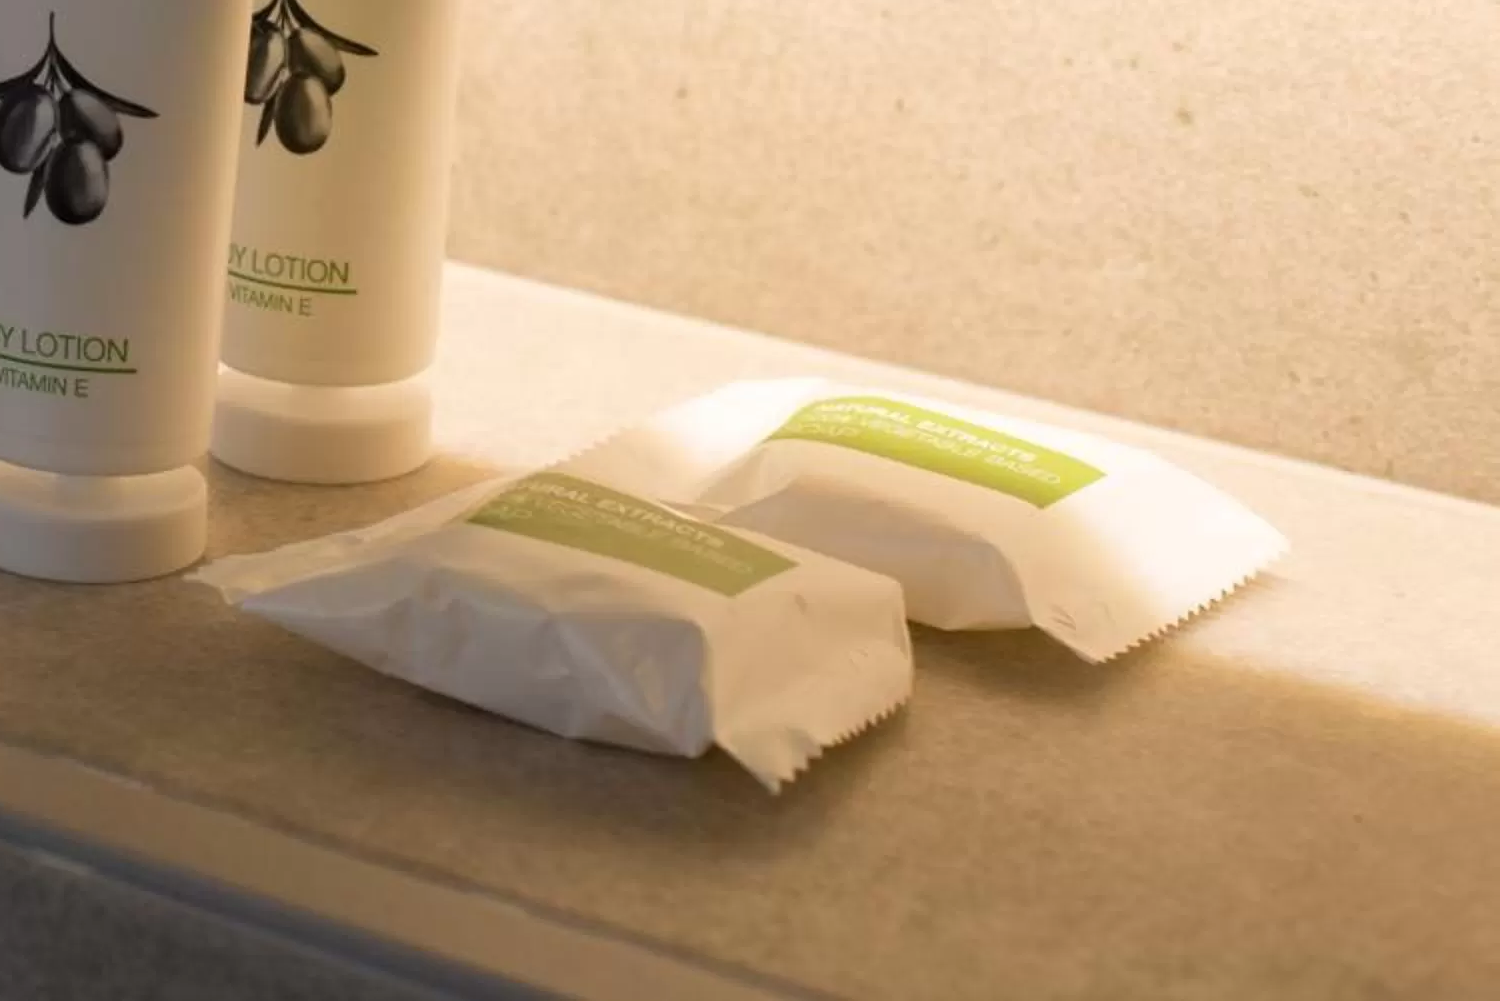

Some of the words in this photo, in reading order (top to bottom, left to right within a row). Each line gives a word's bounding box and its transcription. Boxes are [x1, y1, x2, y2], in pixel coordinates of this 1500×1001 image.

[252, 249, 349, 284] LOTION
[299, 297, 313, 317] E
[21, 327, 129, 363] LOTION
[74, 378, 90, 399] E
